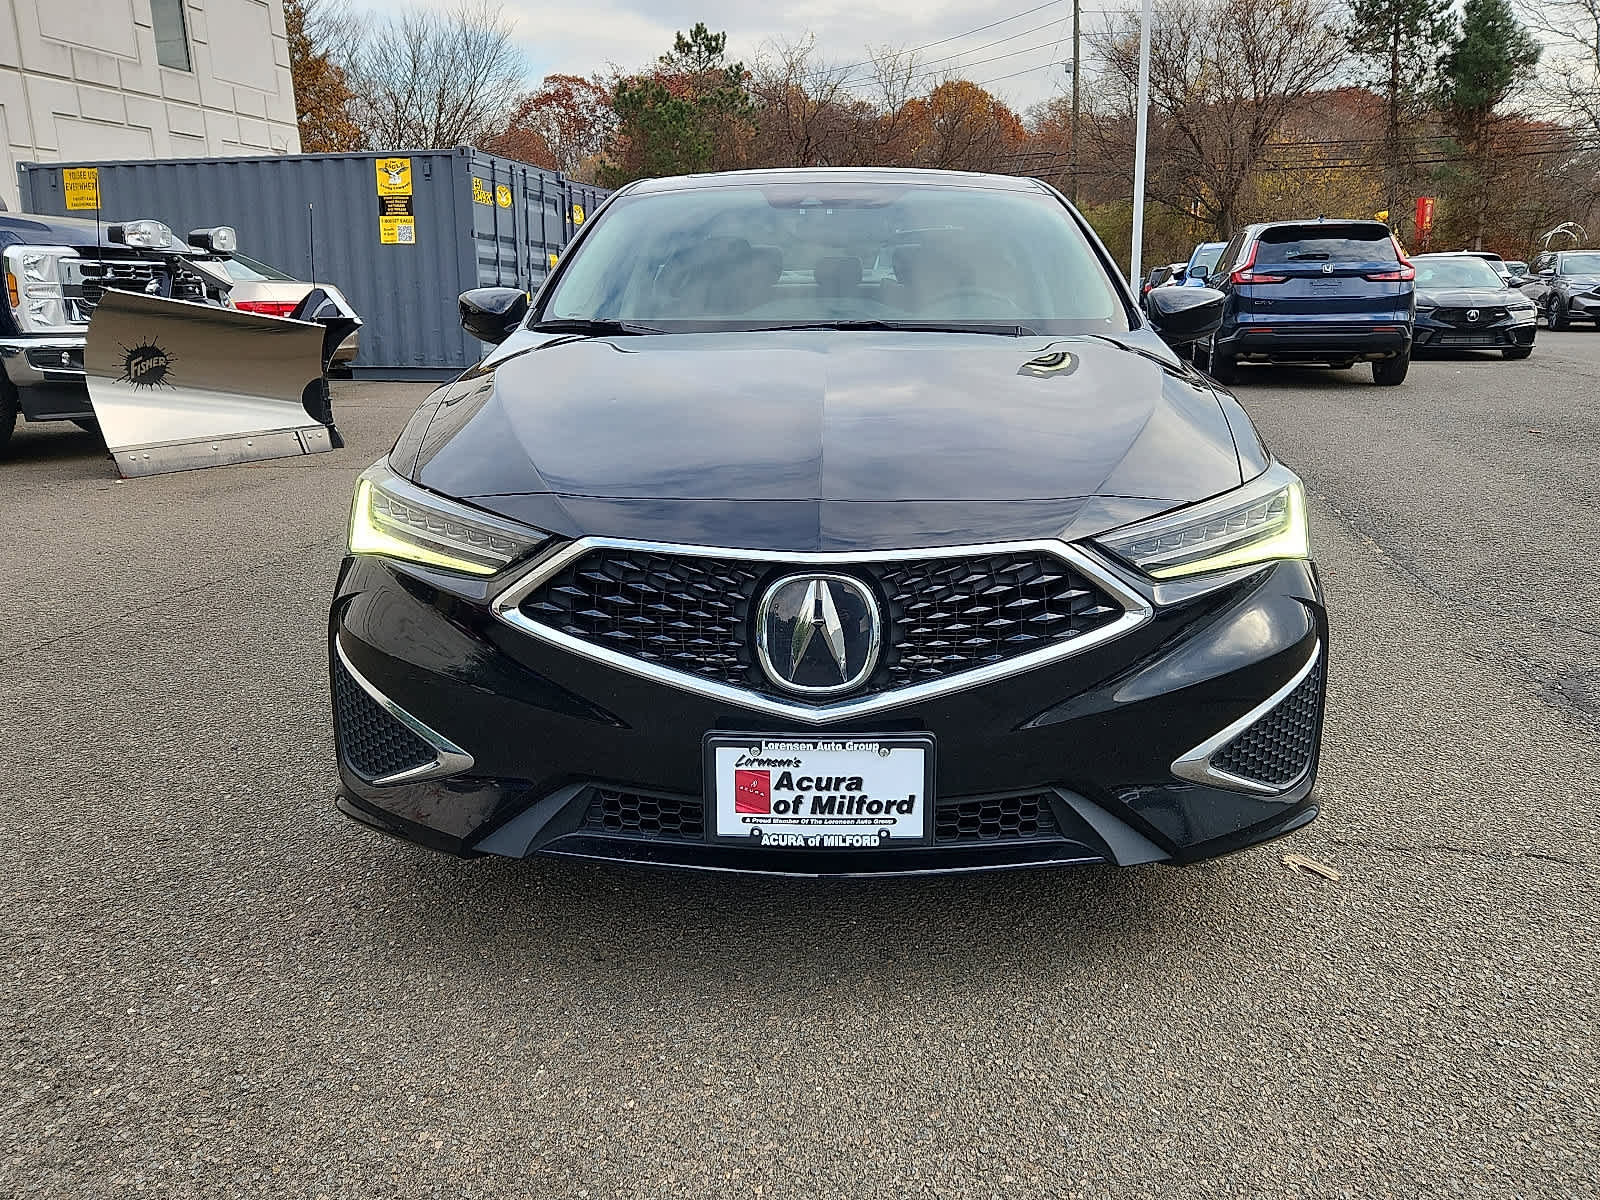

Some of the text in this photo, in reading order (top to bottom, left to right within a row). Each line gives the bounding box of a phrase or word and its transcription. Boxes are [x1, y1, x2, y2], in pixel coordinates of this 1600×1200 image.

[130, 355, 166, 379] FISHER
[762, 740, 880, 753] Lorensen Auto Group
[735, 754, 802, 768] Lorensen's
[773, 771, 864, 792] Acura
[773, 794, 916, 815] of Milford
[761, 834, 880, 847] ACURA of MILFORD
